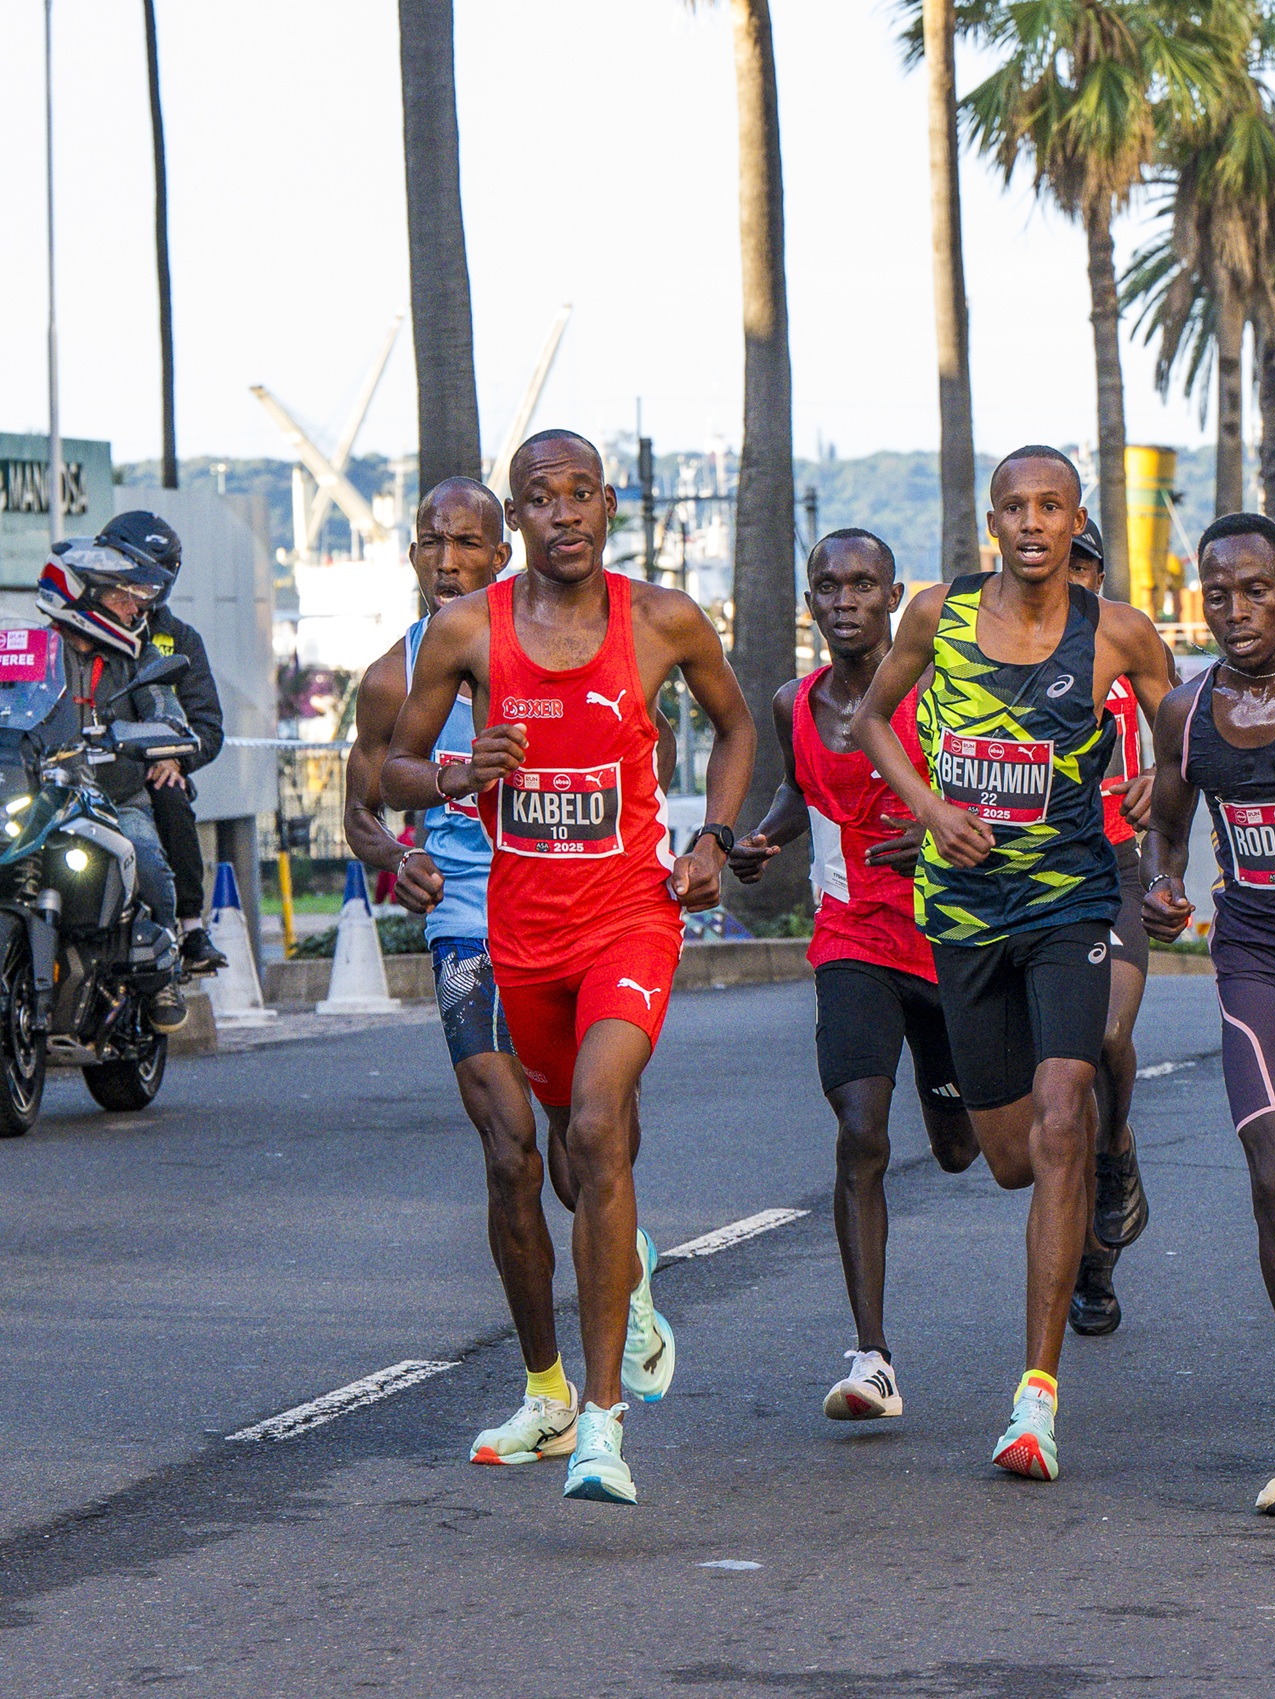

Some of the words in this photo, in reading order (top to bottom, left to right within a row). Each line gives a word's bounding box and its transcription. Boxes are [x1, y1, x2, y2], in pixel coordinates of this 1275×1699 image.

[503, 697, 562, 718] BOXER
[942, 751, 1046, 794] BENJAMIN
[980, 792, 997, 806] 22
[513, 790, 604, 825] KABELO
[983, 808, 1011, 820] 2025
[550, 826, 568, 840] 10
[553, 843, 584, 852] 2025
